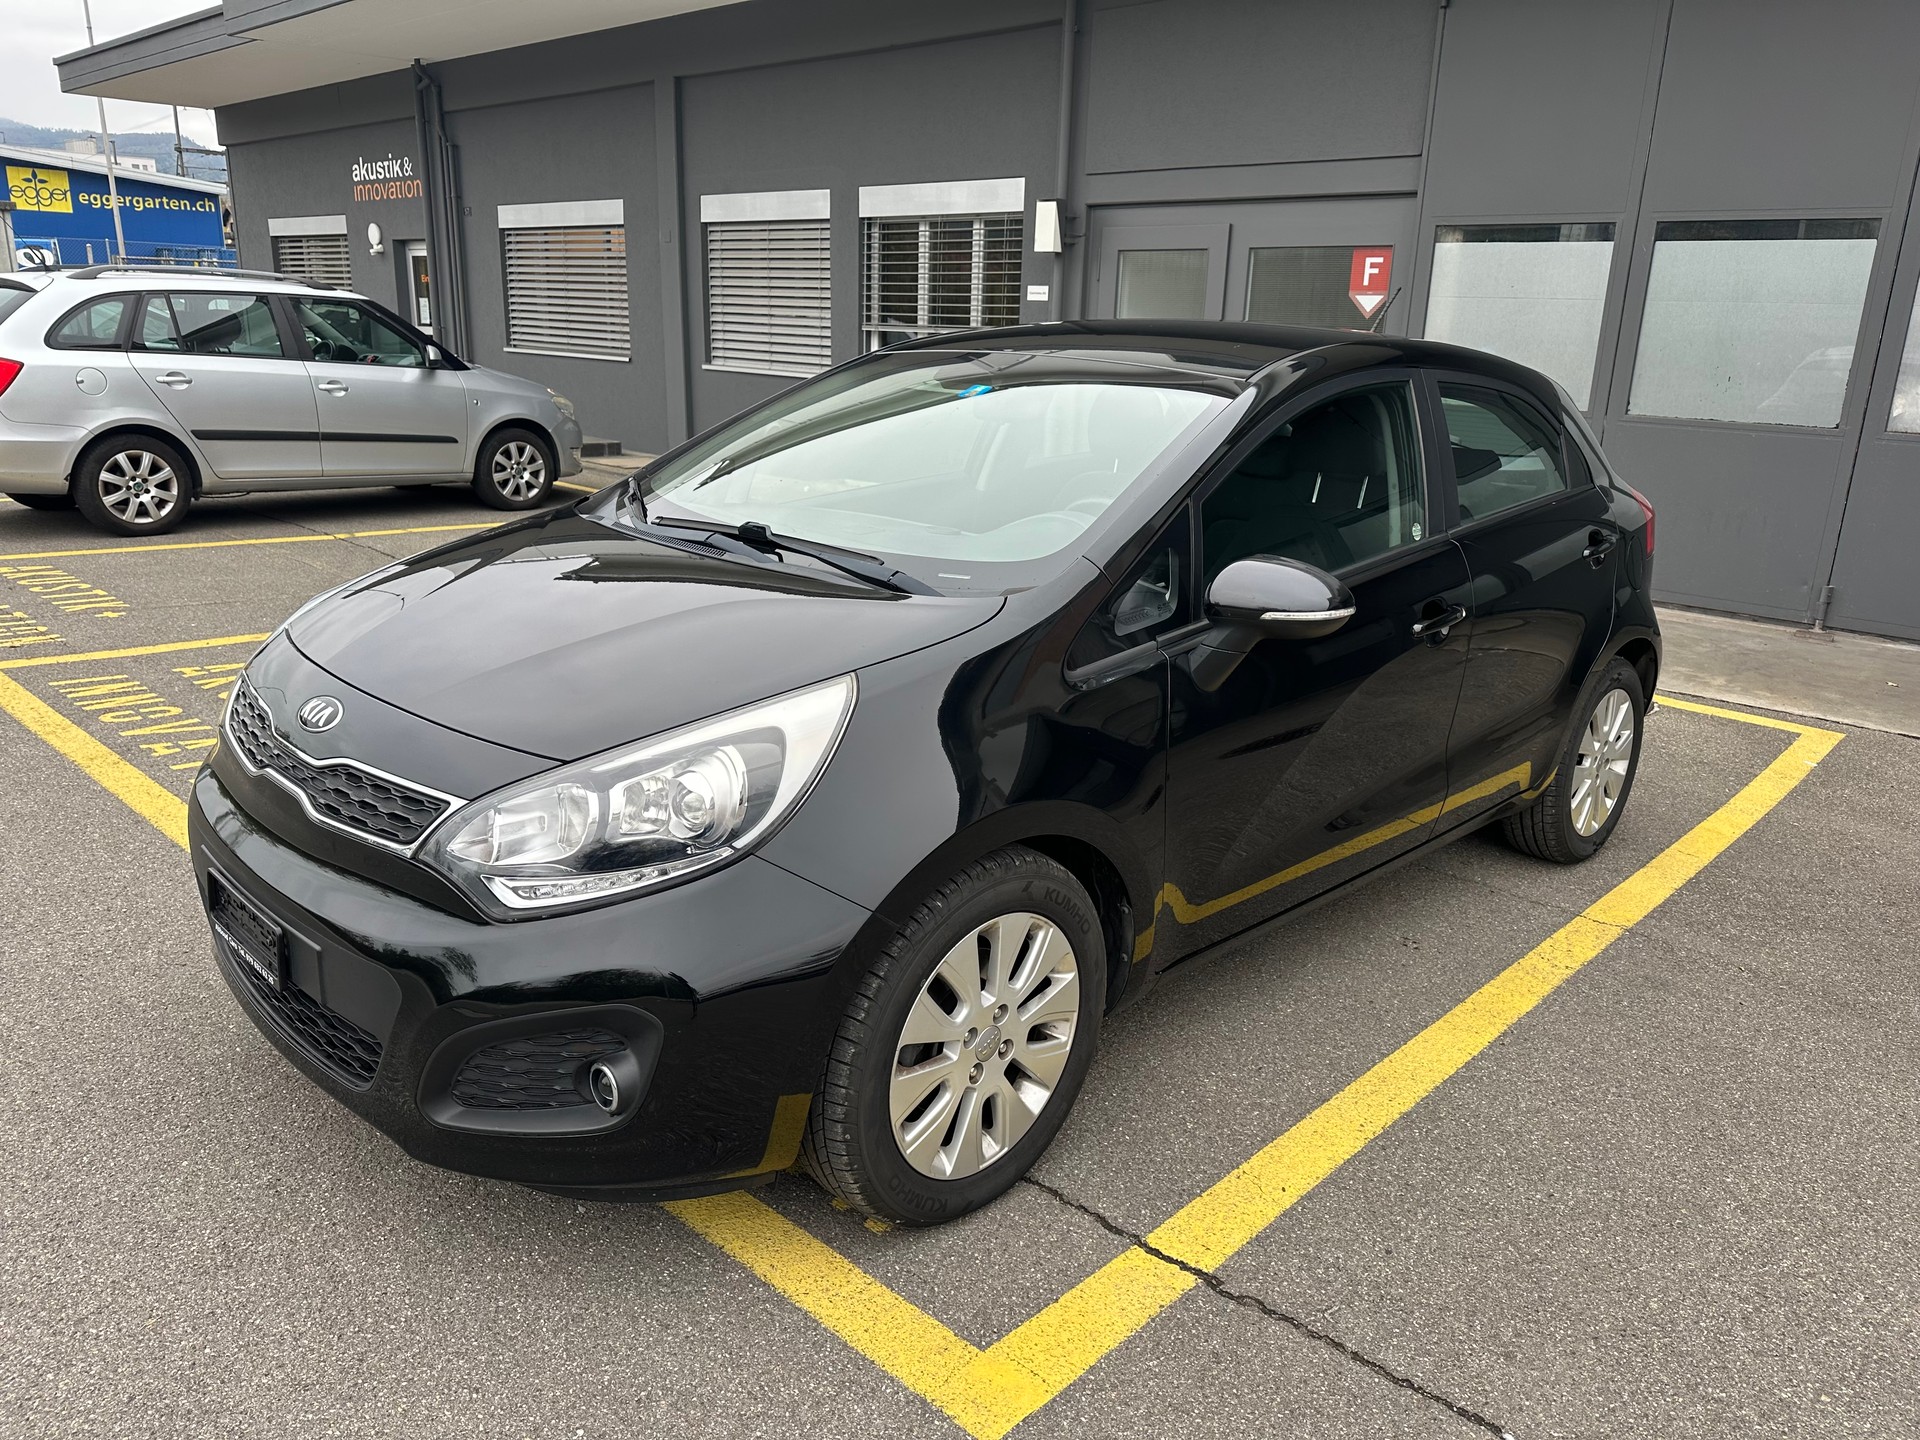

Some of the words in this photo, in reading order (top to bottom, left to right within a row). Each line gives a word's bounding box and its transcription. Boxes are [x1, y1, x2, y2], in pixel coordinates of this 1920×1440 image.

[9, 184, 70, 207] egger
[78, 191, 216, 213] eggergarten.ch
[353, 179, 423, 202] innovation
[1363, 256, 1384, 286] F
[300, 698, 335, 727] KIA
[1044, 886, 1091, 935] KUMHO
